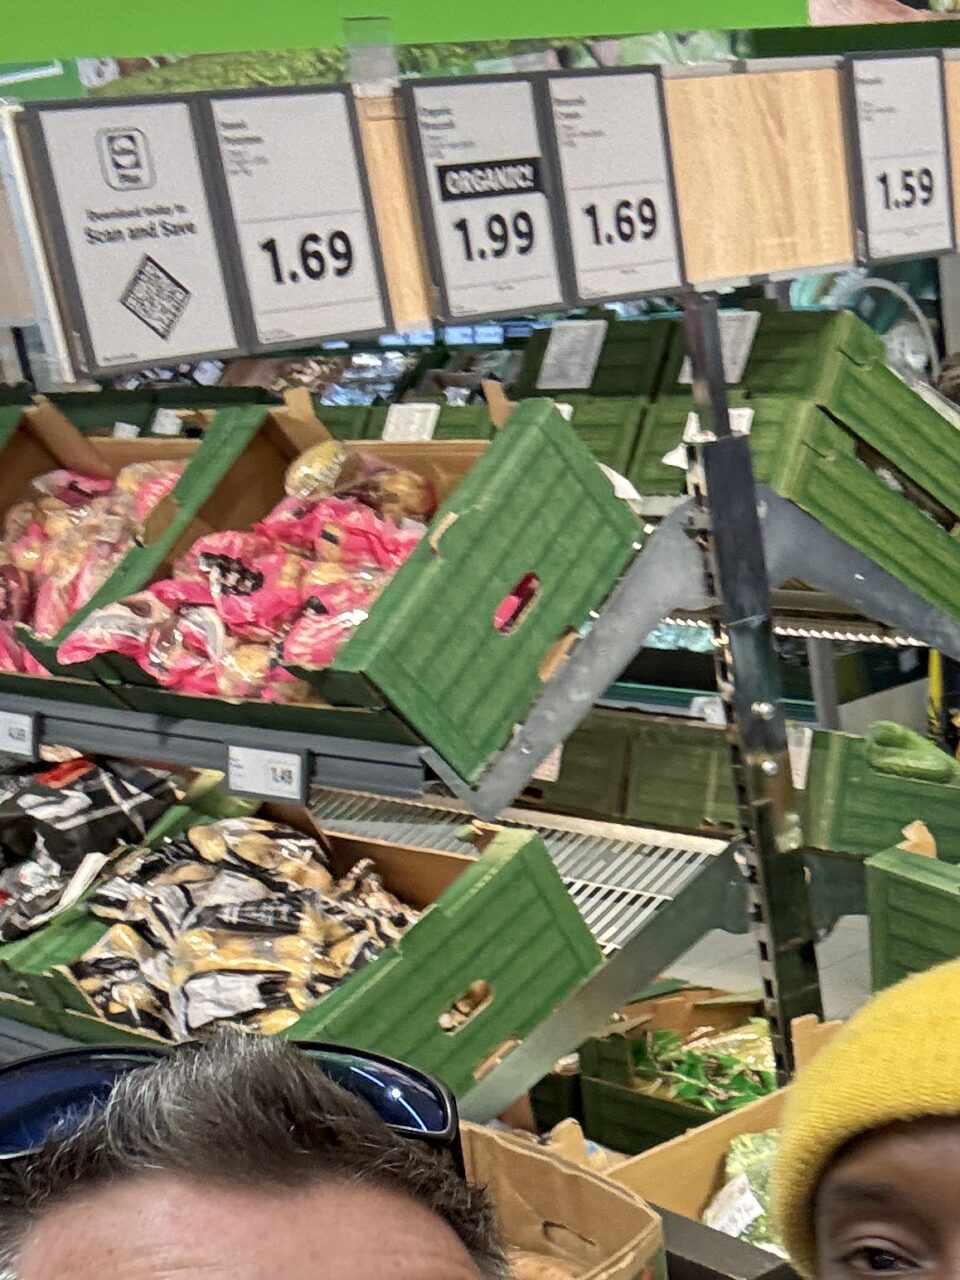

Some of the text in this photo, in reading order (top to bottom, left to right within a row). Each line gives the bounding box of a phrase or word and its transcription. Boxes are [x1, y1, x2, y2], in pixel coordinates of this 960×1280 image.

[877, 167, 935, 210] 1.59
[84, 226, 126, 245] Scan
[127, 221, 159, 240] and
[454, 210, 534, 261] 1.99
[583, 198, 657, 246] 1.69
[260, 230, 353, 285] 1.69
